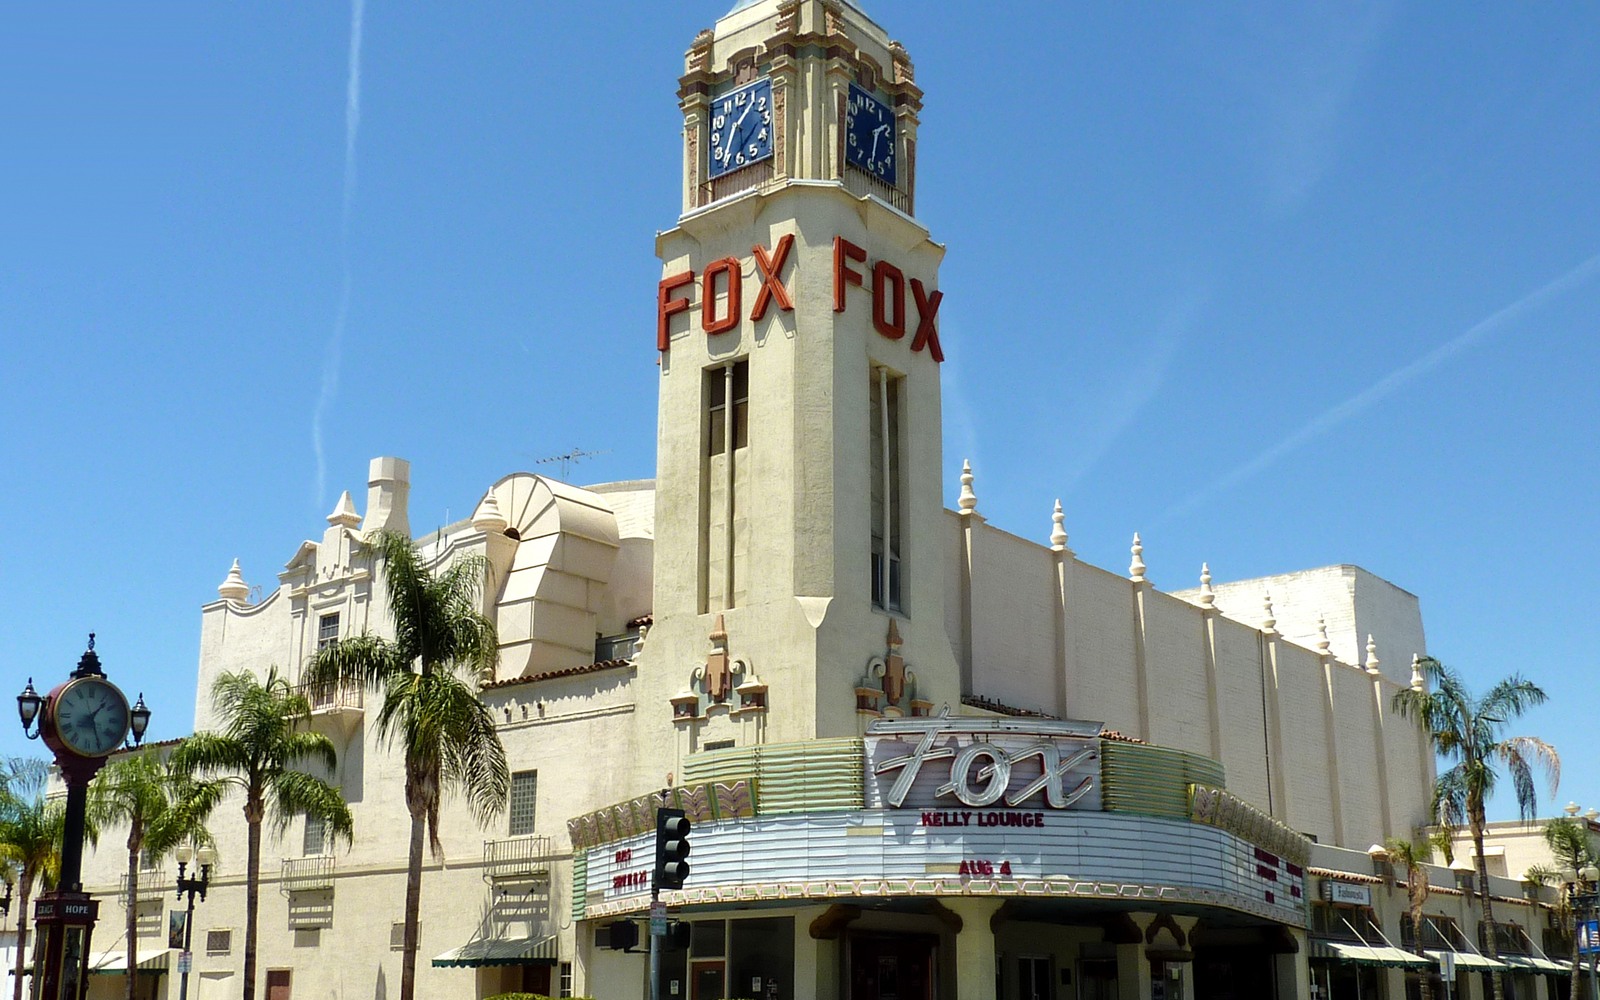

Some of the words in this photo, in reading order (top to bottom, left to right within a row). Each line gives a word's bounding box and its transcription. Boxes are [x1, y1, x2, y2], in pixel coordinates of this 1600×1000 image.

[735, 91, 747, 107] 12
[751, 90, 756, 102] 1
[856, 94, 864, 109] 11
[723, 100, 732, 115] 11
[758, 96, 766, 112] 2
[847, 100, 858, 116] 10
[865, 97, 875, 113] 12
[762, 110, 770, 125] 3
[847, 115, 854, 129] 9
[878, 108, 882, 122] 1
[712, 115, 725, 130] 10
[757, 127, 768, 141] 4
[884, 124, 891, 137] 2
[711, 132, 720, 146] 9
[849, 132, 857, 147] 8
[714, 146, 723, 160] 8
[749, 143, 758, 157] 5
[857, 148, 864, 159] 7
[888, 141, 894, 155] 3
[735, 151, 745, 165] 6
[867, 157, 874, 171] 6
[884, 156, 891, 168] 4
[878, 161, 884, 175] 5
[657, 234, 795, 352] FOX
[833, 235, 944, 363] FOX
[921, 812, 972, 827] KELLY
[978, 812, 1044, 827] LOUNGE
[959, 860, 993, 875] AUG
[1000, 860, 1012, 875] 4
[65, 905, 89, 914] HOPE
